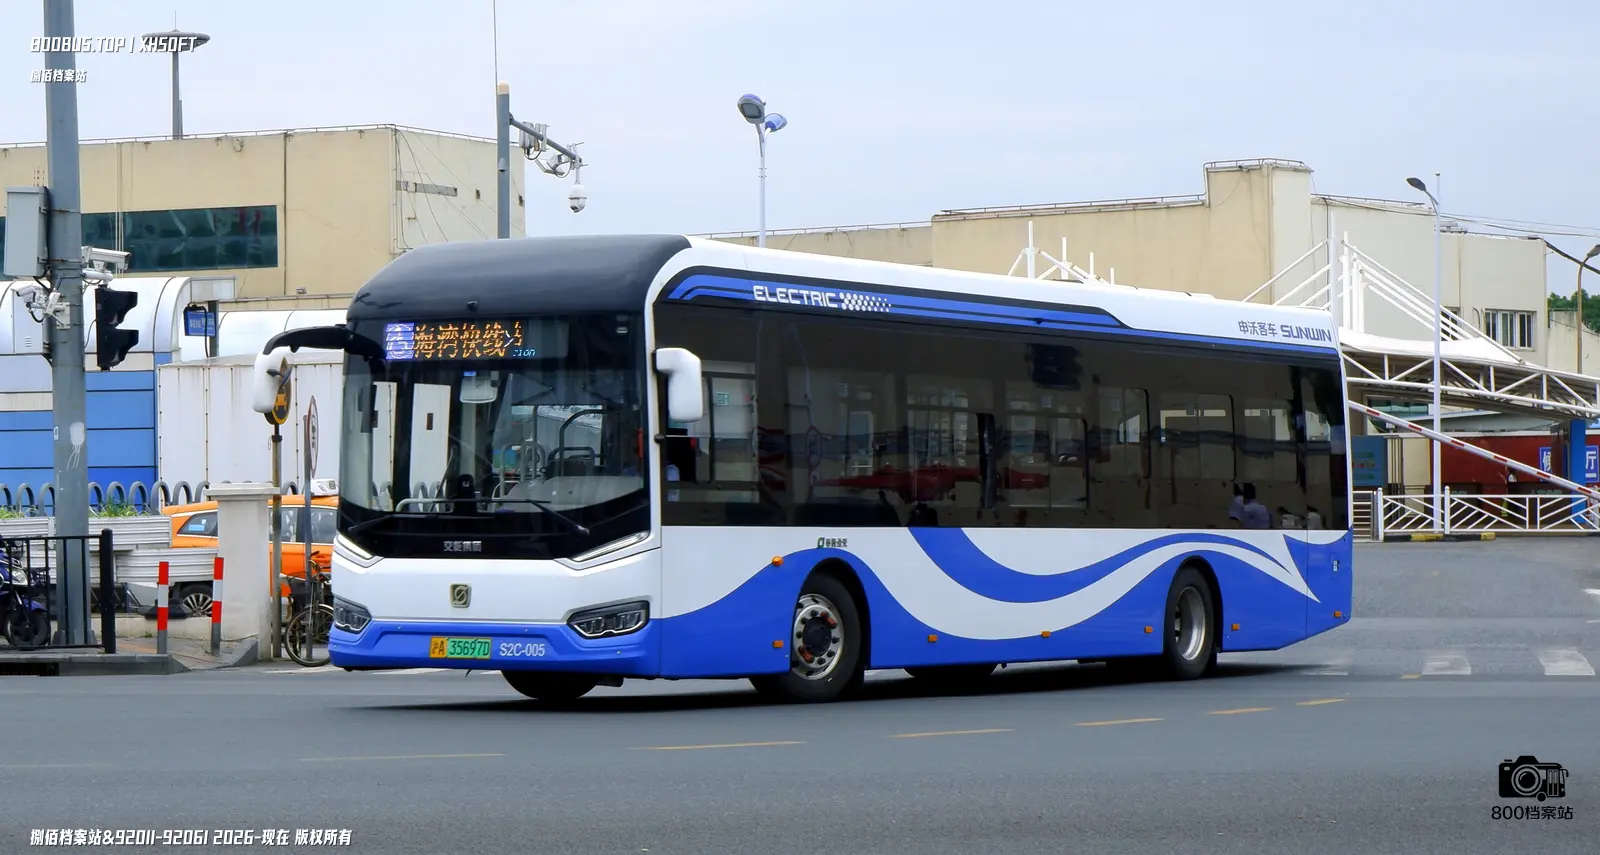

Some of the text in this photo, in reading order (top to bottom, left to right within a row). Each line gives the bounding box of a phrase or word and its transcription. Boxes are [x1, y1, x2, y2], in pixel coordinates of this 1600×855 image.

[752, 285, 839, 308] ELECTRIC
[1238, 320, 1332, 342] 申沃客车 SUNWIN
[499, 643, 546, 657] S2C-005
